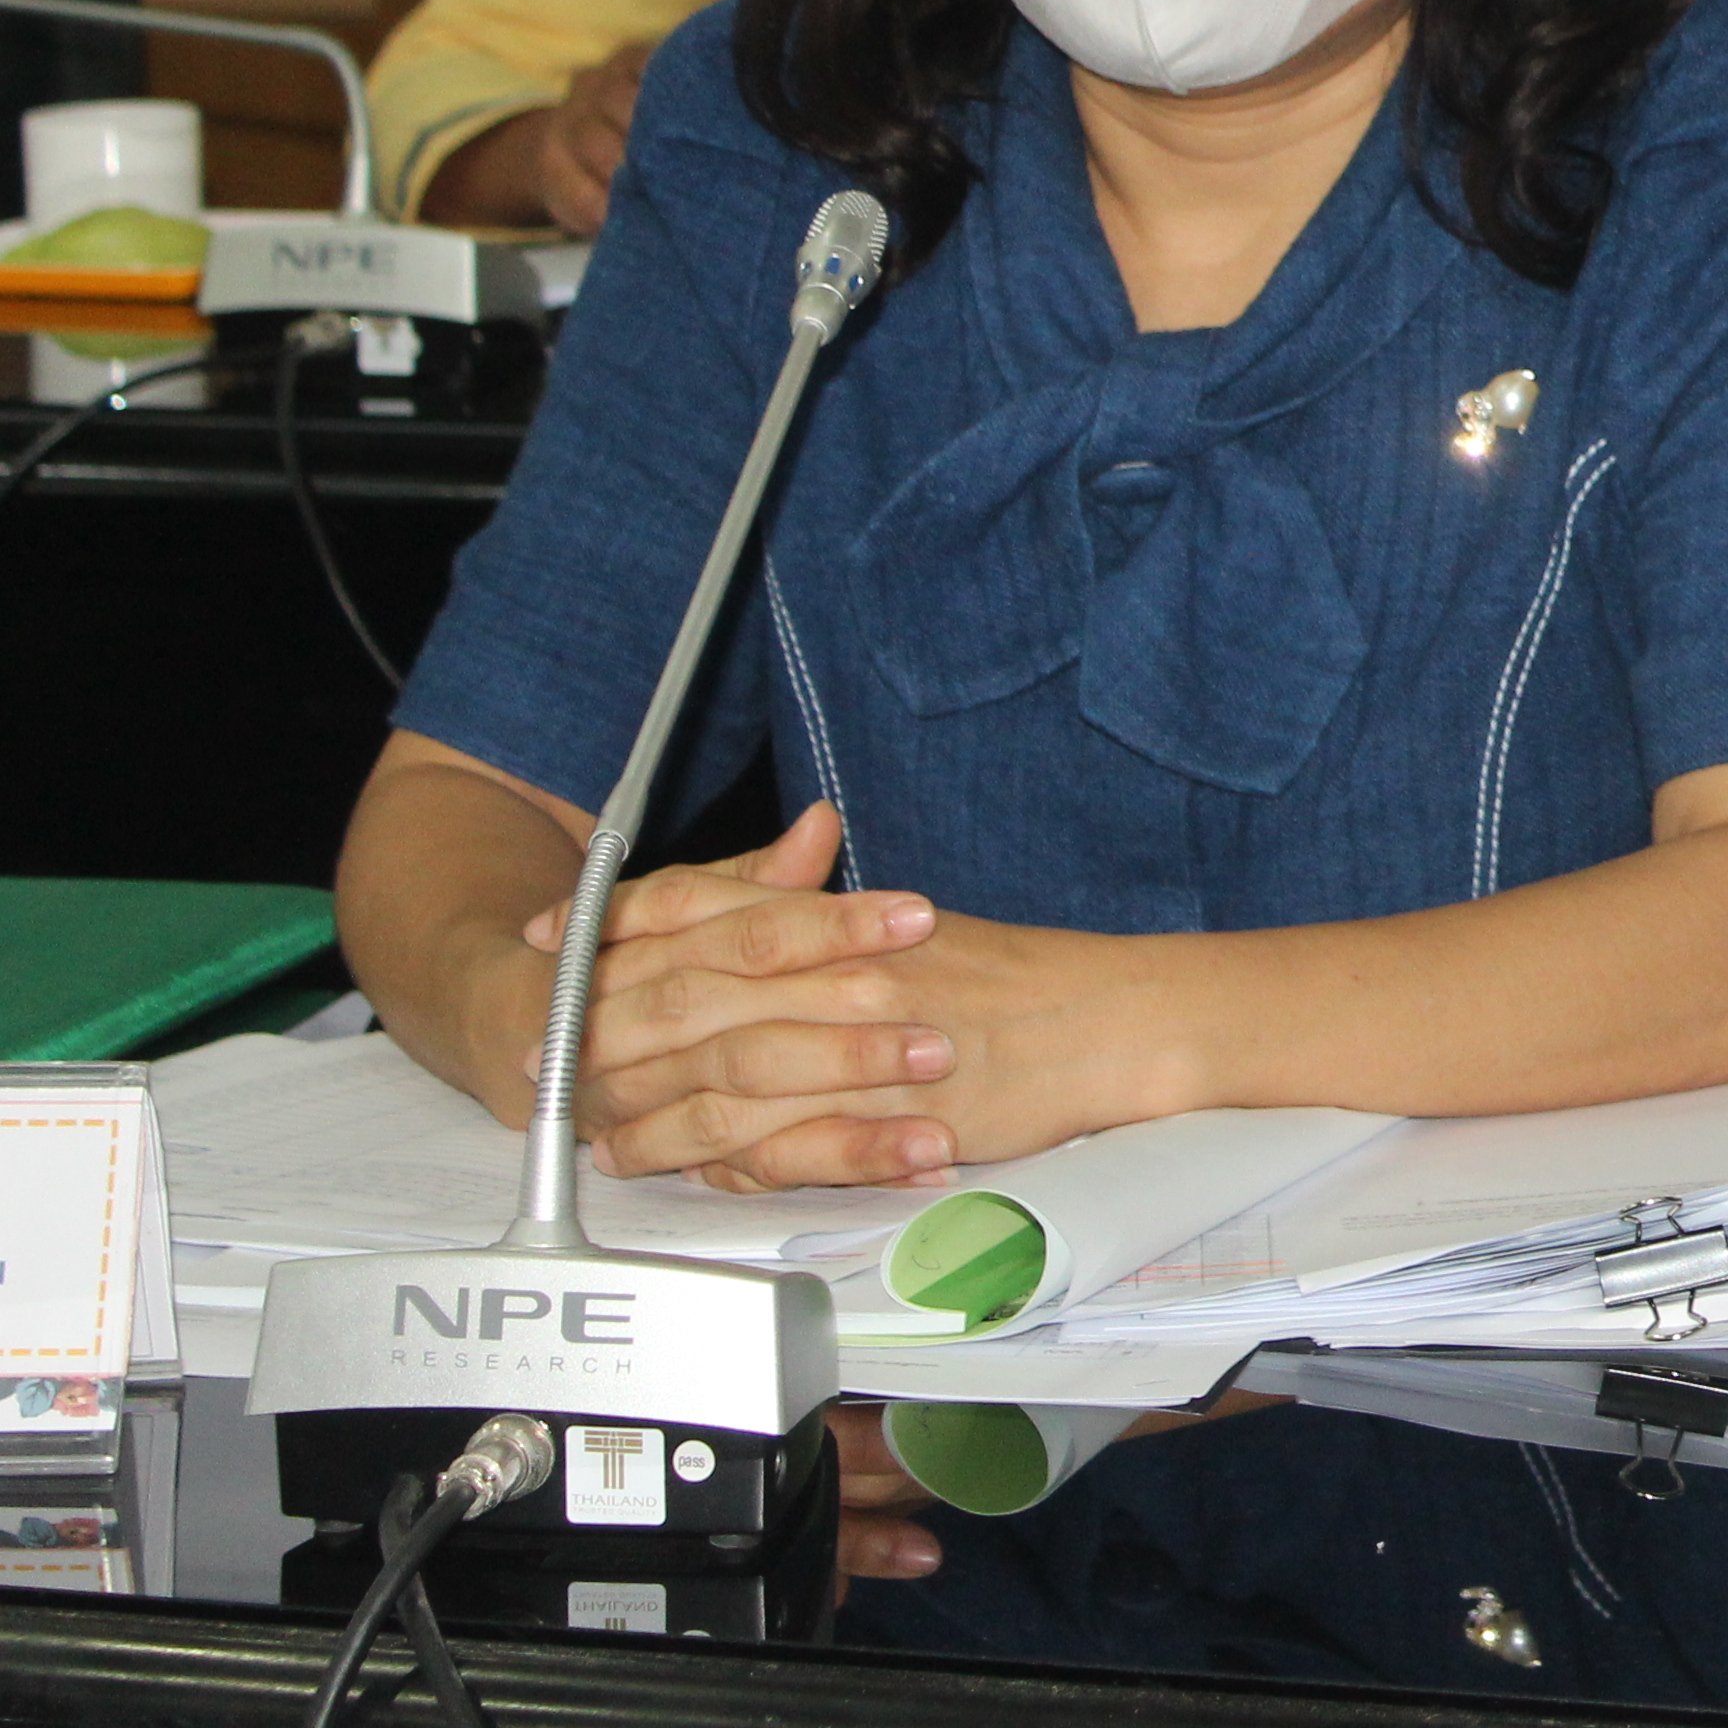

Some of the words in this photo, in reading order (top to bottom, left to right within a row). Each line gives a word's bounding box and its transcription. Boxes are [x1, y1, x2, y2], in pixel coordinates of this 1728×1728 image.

[270, 238, 396, 273] NPE
[393, 1284, 636, 1345] NPE
[391, 1349, 632, 1374] RESEARCH
[678, 1455, 706, 1470] pass
[571, 1493, 658, 1508] THAILAND
